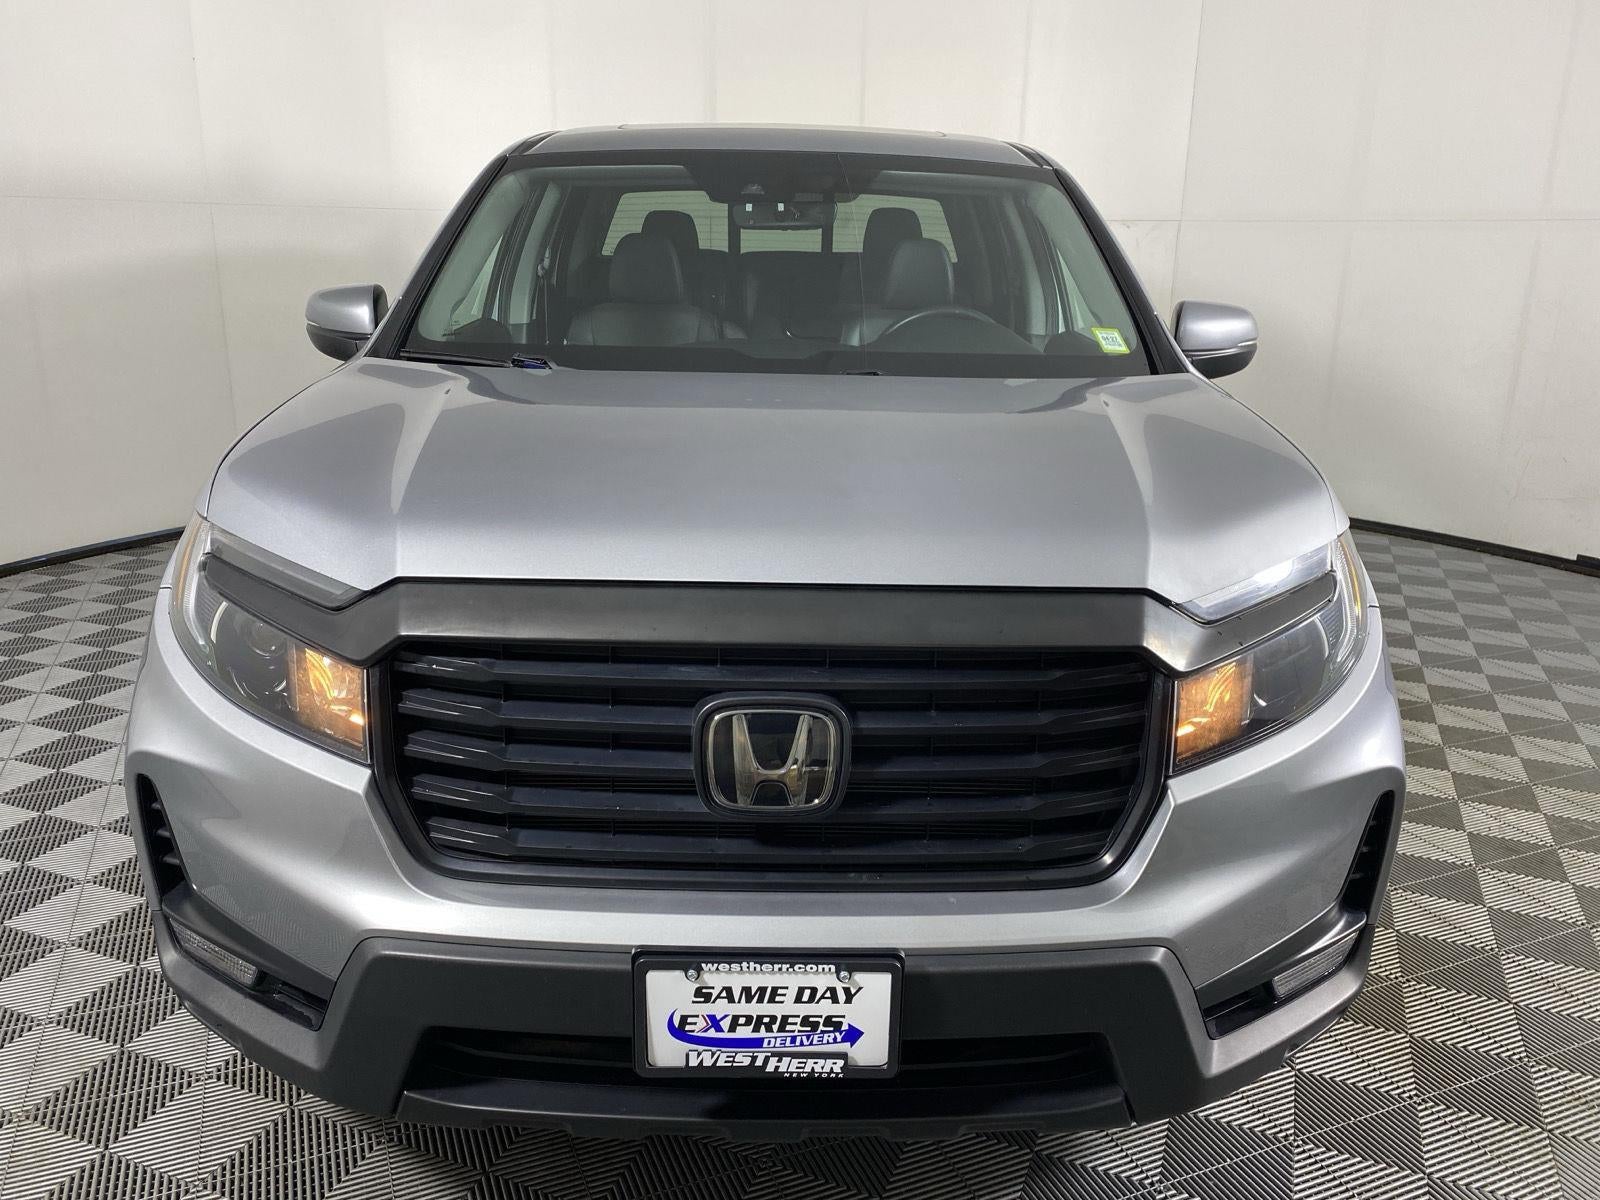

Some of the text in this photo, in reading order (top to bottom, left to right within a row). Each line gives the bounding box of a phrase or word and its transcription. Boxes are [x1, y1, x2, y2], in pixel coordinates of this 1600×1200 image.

[701, 961, 836, 973] westherr.com
[691, 985, 865, 1005] SAME DAY
[677, 1013, 846, 1034] EXPRESS
[762, 1032, 846, 1048] DELIVERY
